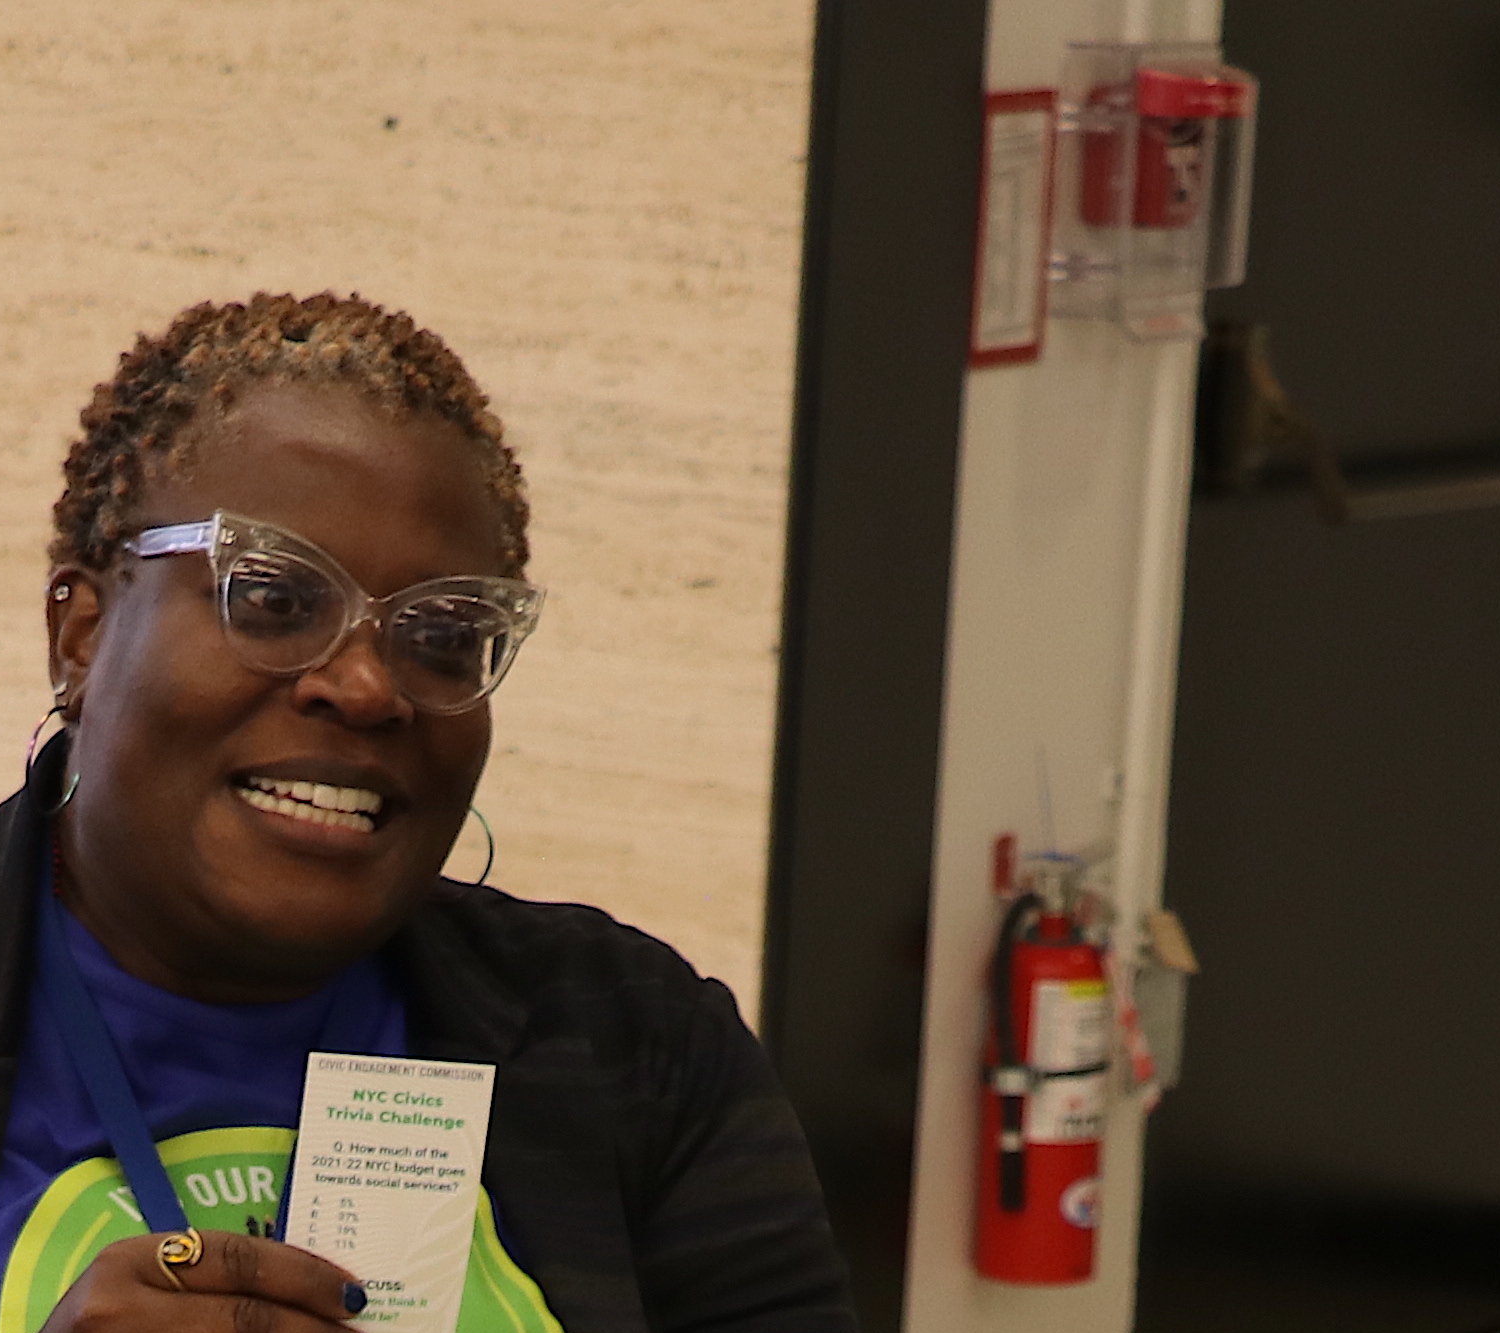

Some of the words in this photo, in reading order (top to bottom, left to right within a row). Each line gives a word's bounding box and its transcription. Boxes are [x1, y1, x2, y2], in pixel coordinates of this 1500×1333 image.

[319, 1059, 344, 1071] CIVIC
[349, 1062, 416, 1077] ENGAGEMENT
[420, 1066, 484, 1081] COMMISSION
[353, 1089, 387, 1104] NYC
[394, 1092, 444, 1107] Civics
[326, 1106, 373, 1122] Trivia
[380, 1111, 464, 1129] Challenge
[350, 1143, 376, 1154] How
[380, 1146, 412, 1158] much
[416, 1147, 428, 1158] of
[431, 1149, 448, 1158] the
[366, 1160, 391, 1172] NYC
[394, 1163, 435, 1177] budget
[438, 1168, 465, 1178] goes
[186, 1165, 278, 1207] OUR
[315, 1174, 362, 1186] towards
[366, 1177, 401, 1188] social
[404, 1181, 459, 1192] services?
